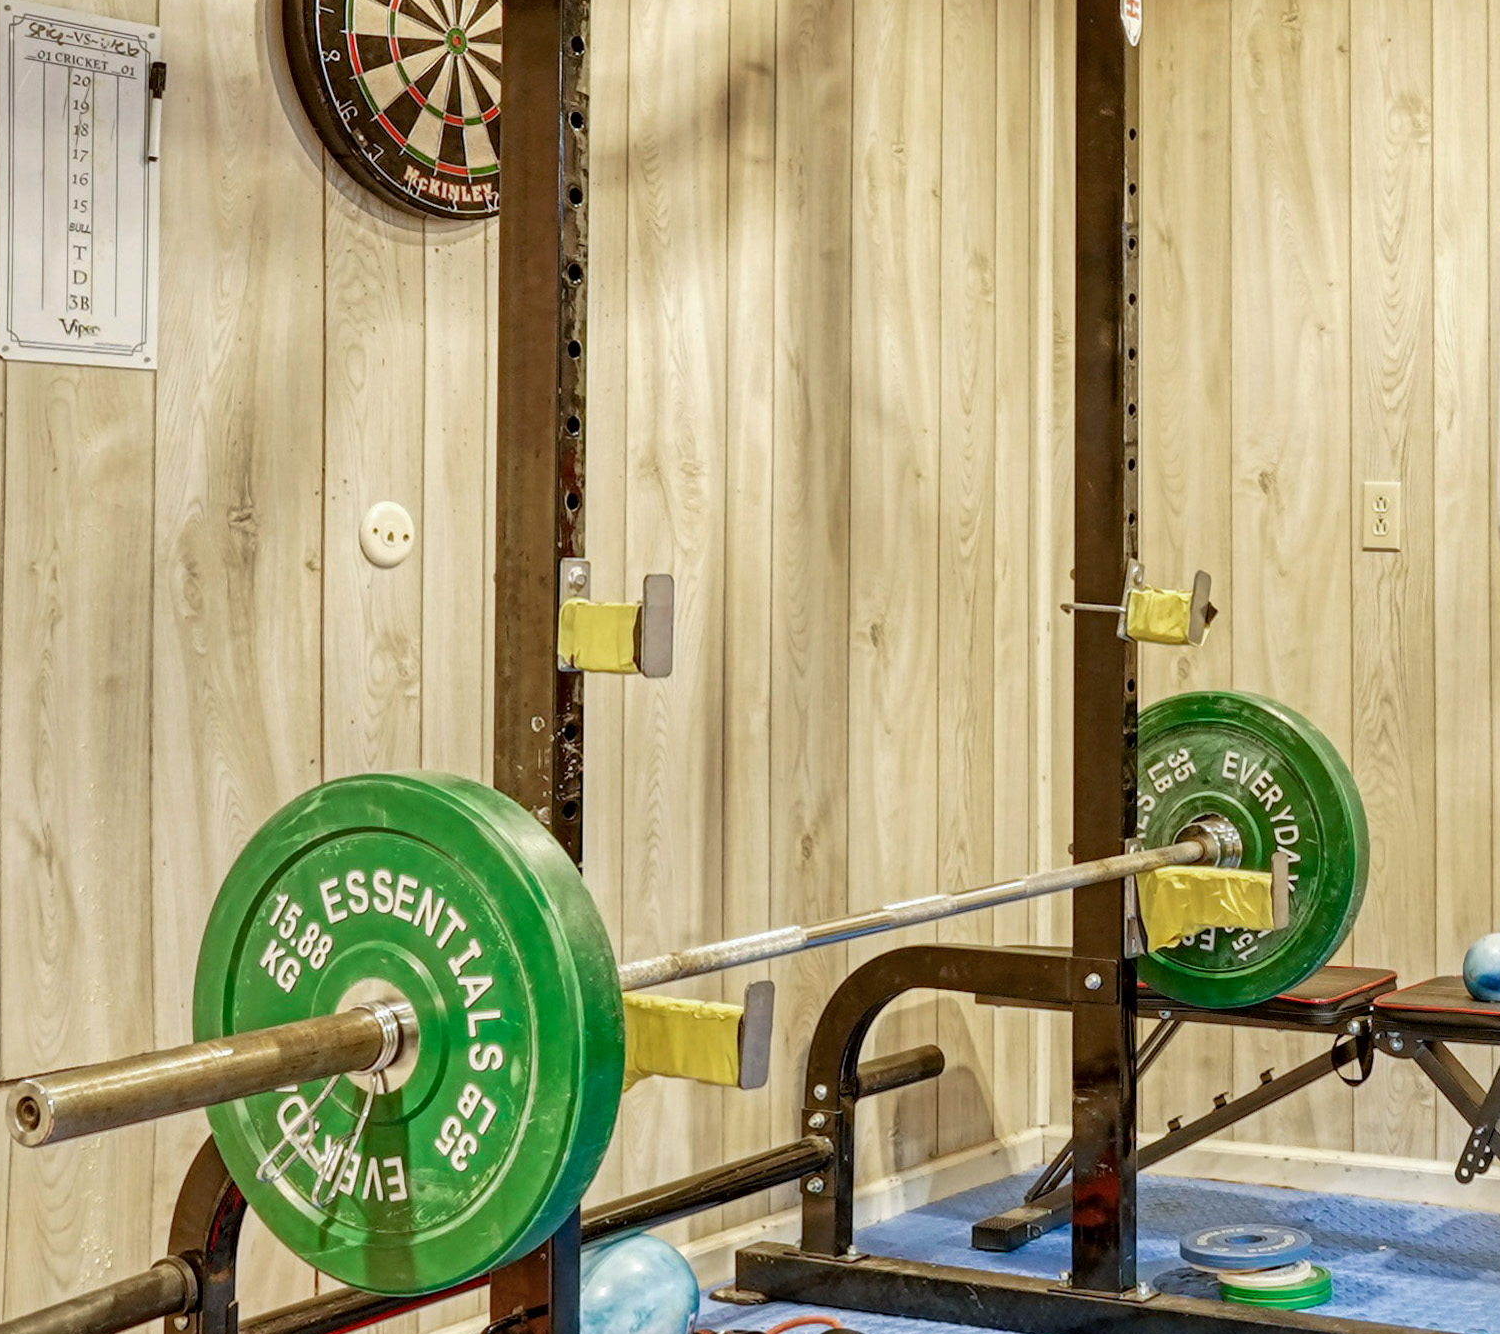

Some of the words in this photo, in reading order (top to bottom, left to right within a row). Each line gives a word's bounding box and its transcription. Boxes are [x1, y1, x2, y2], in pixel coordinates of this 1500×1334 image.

[54, 52, 109, 72] CRICKET
[72, 73, 92, 88] 20
[72, 99, 90, 115] 19
[73, 123, 90, 137] 18
[72, 149, 90, 163] 17
[71, 173, 90, 186] 16
[72, 199, 89, 213] 15
[68, 222, 92, 235] BULL
[72, 244, 88, 261] T
[72, 269, 88, 285] D
[68, 294, 91, 312] 3B
[58, 317, 101, 339] Viper
[1166, 747, 1197, 784] 35
[1147, 761, 1174, 795] LB
[268, 893, 333, 970] 15.88
[259, 939, 302, 994] KG
[318, 869, 504, 1072] ESSENTIALS
[456, 1082, 498, 1135] LB
[434, 1116, 479, 1173] 35
